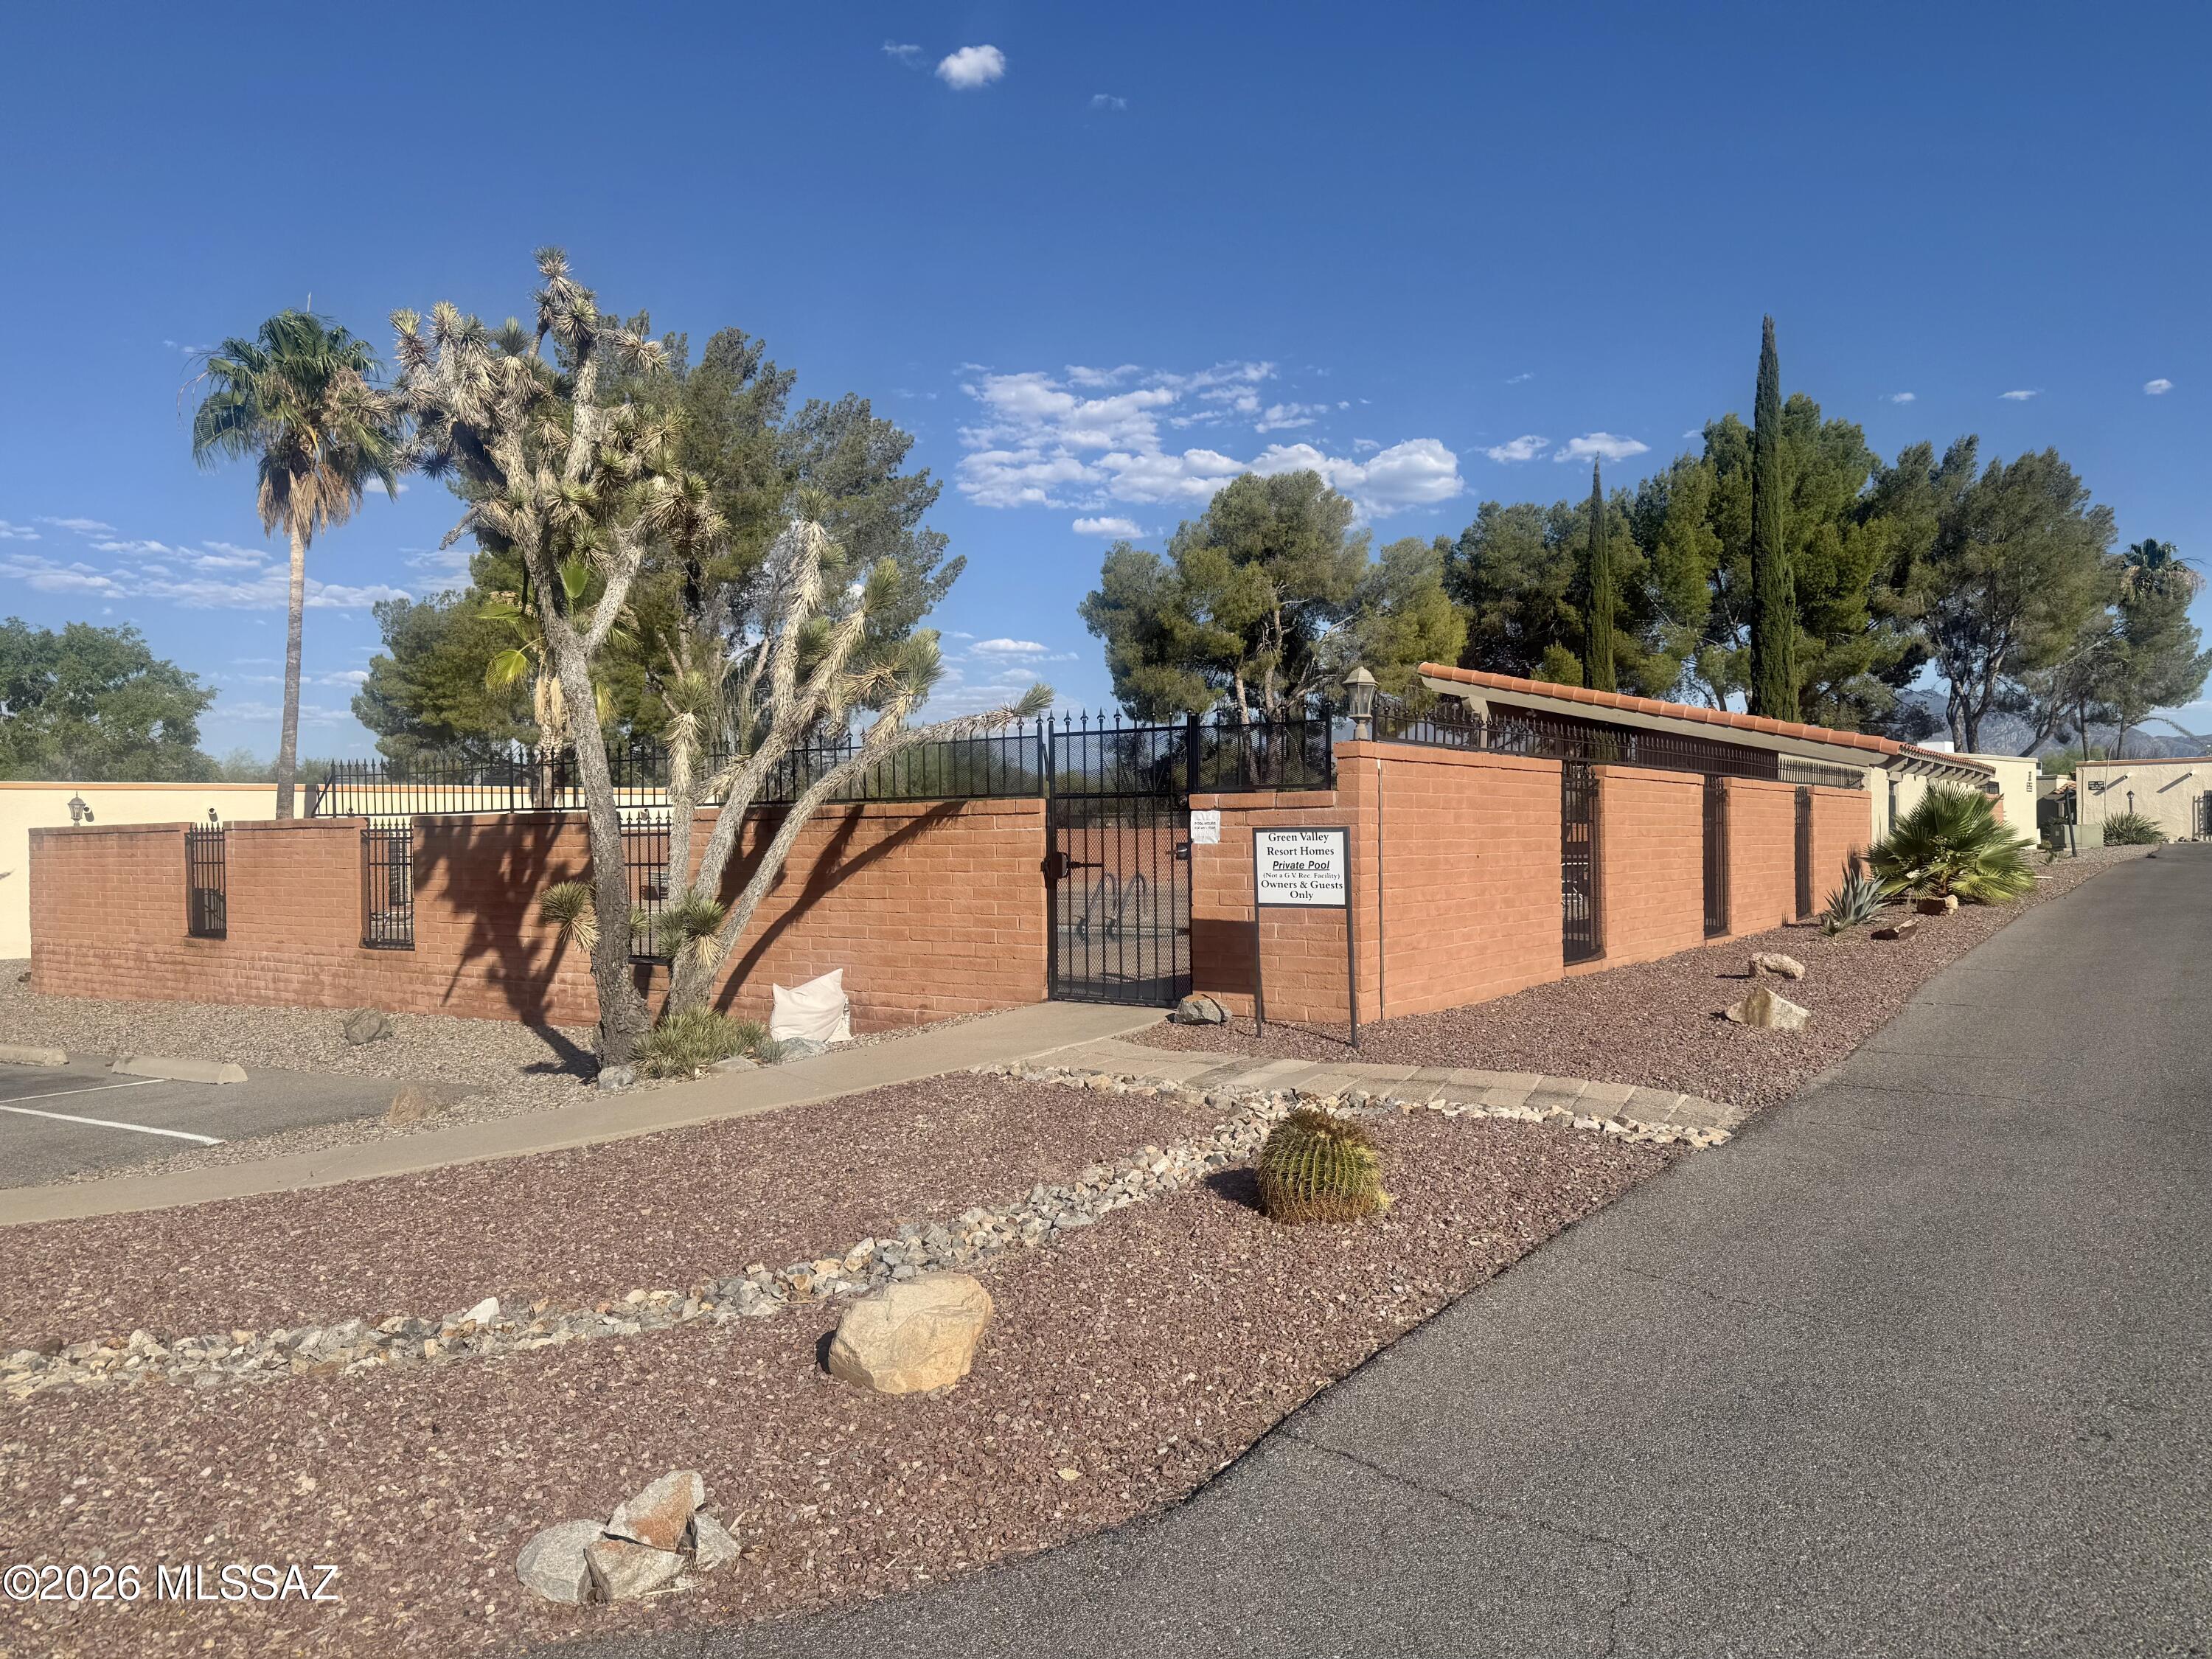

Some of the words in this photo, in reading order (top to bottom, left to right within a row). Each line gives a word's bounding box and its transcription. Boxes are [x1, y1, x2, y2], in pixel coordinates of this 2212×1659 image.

[1268, 833, 1297, 841] Green
[1300, 832, 1329, 843] Valley
[1267, 847, 1297, 855] Resort
[1300, 846, 1335, 855] Homes
[1273, 860, 1304, 869] Private
[1308, 860, 1329, 869] Pool
[1290, 891, 1313, 900] Only
